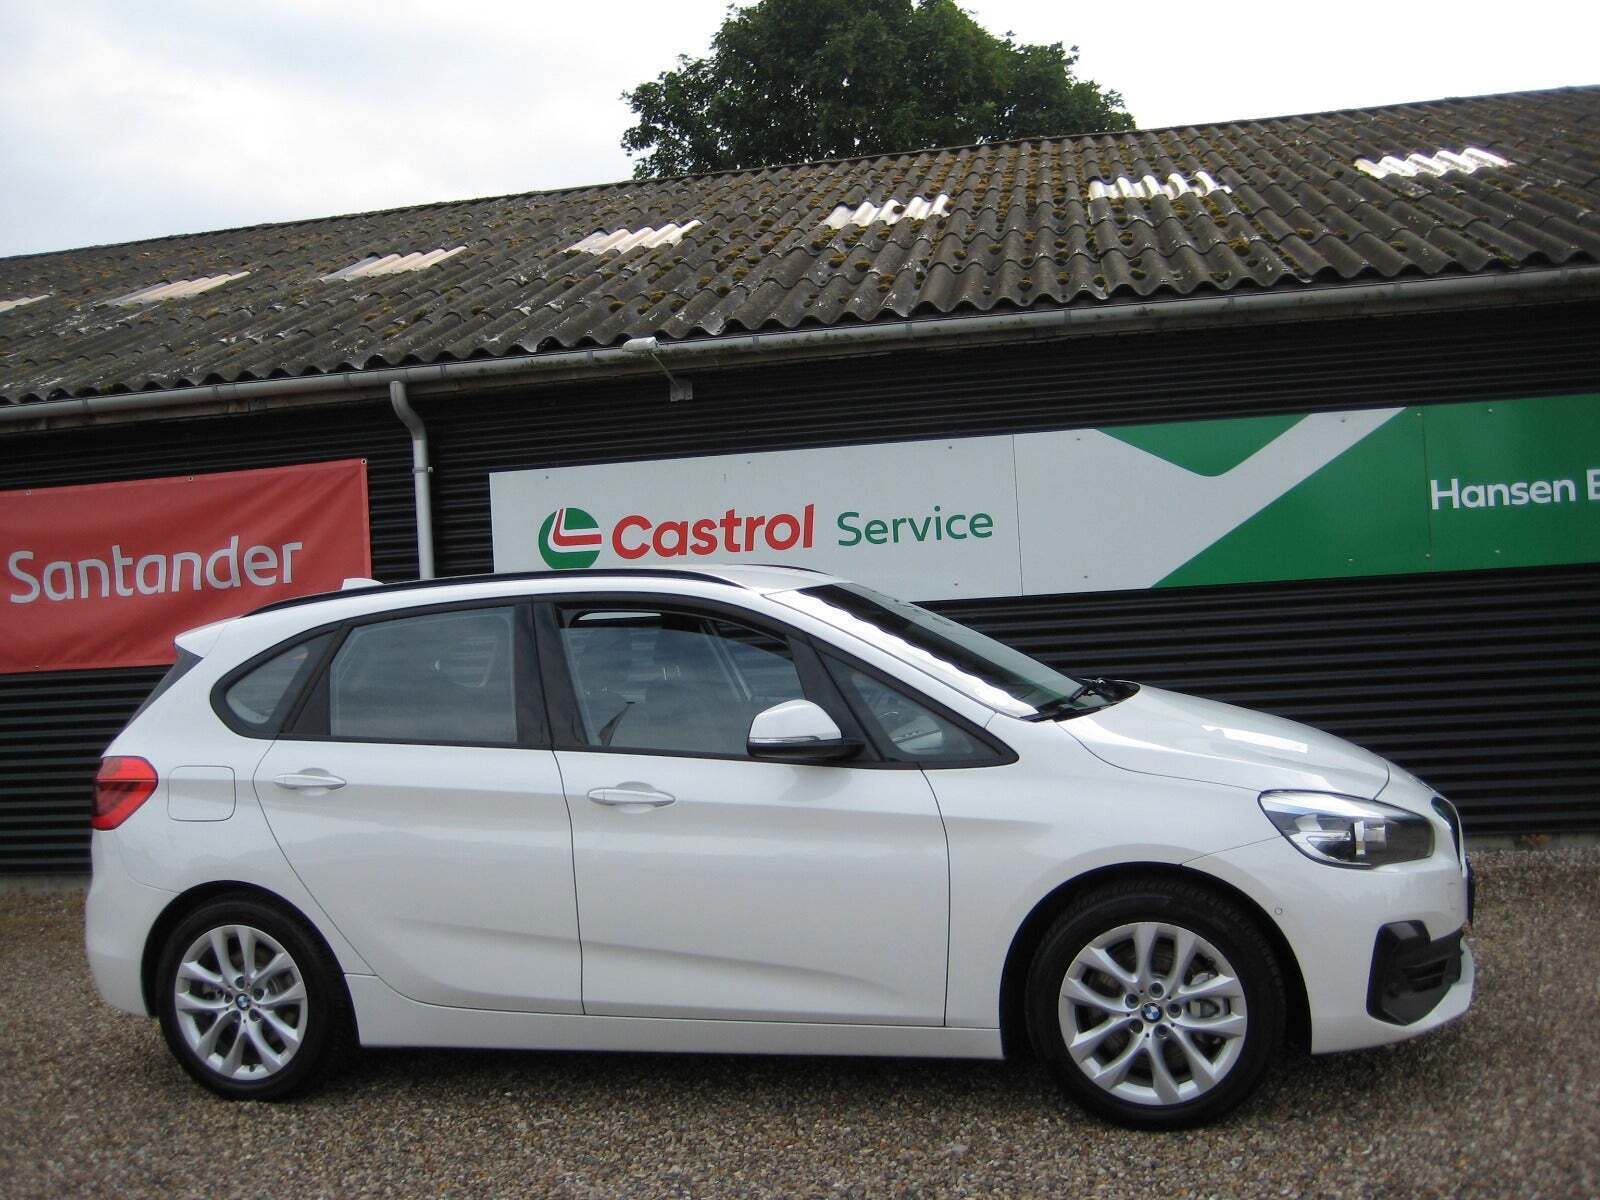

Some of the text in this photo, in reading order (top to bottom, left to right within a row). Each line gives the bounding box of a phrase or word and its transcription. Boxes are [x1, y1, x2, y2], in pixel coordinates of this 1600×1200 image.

[1430, 478, 1576, 510] Hansen
[612, 504, 993, 559] Castrol Service
[8, 535, 303, 603] Santander
